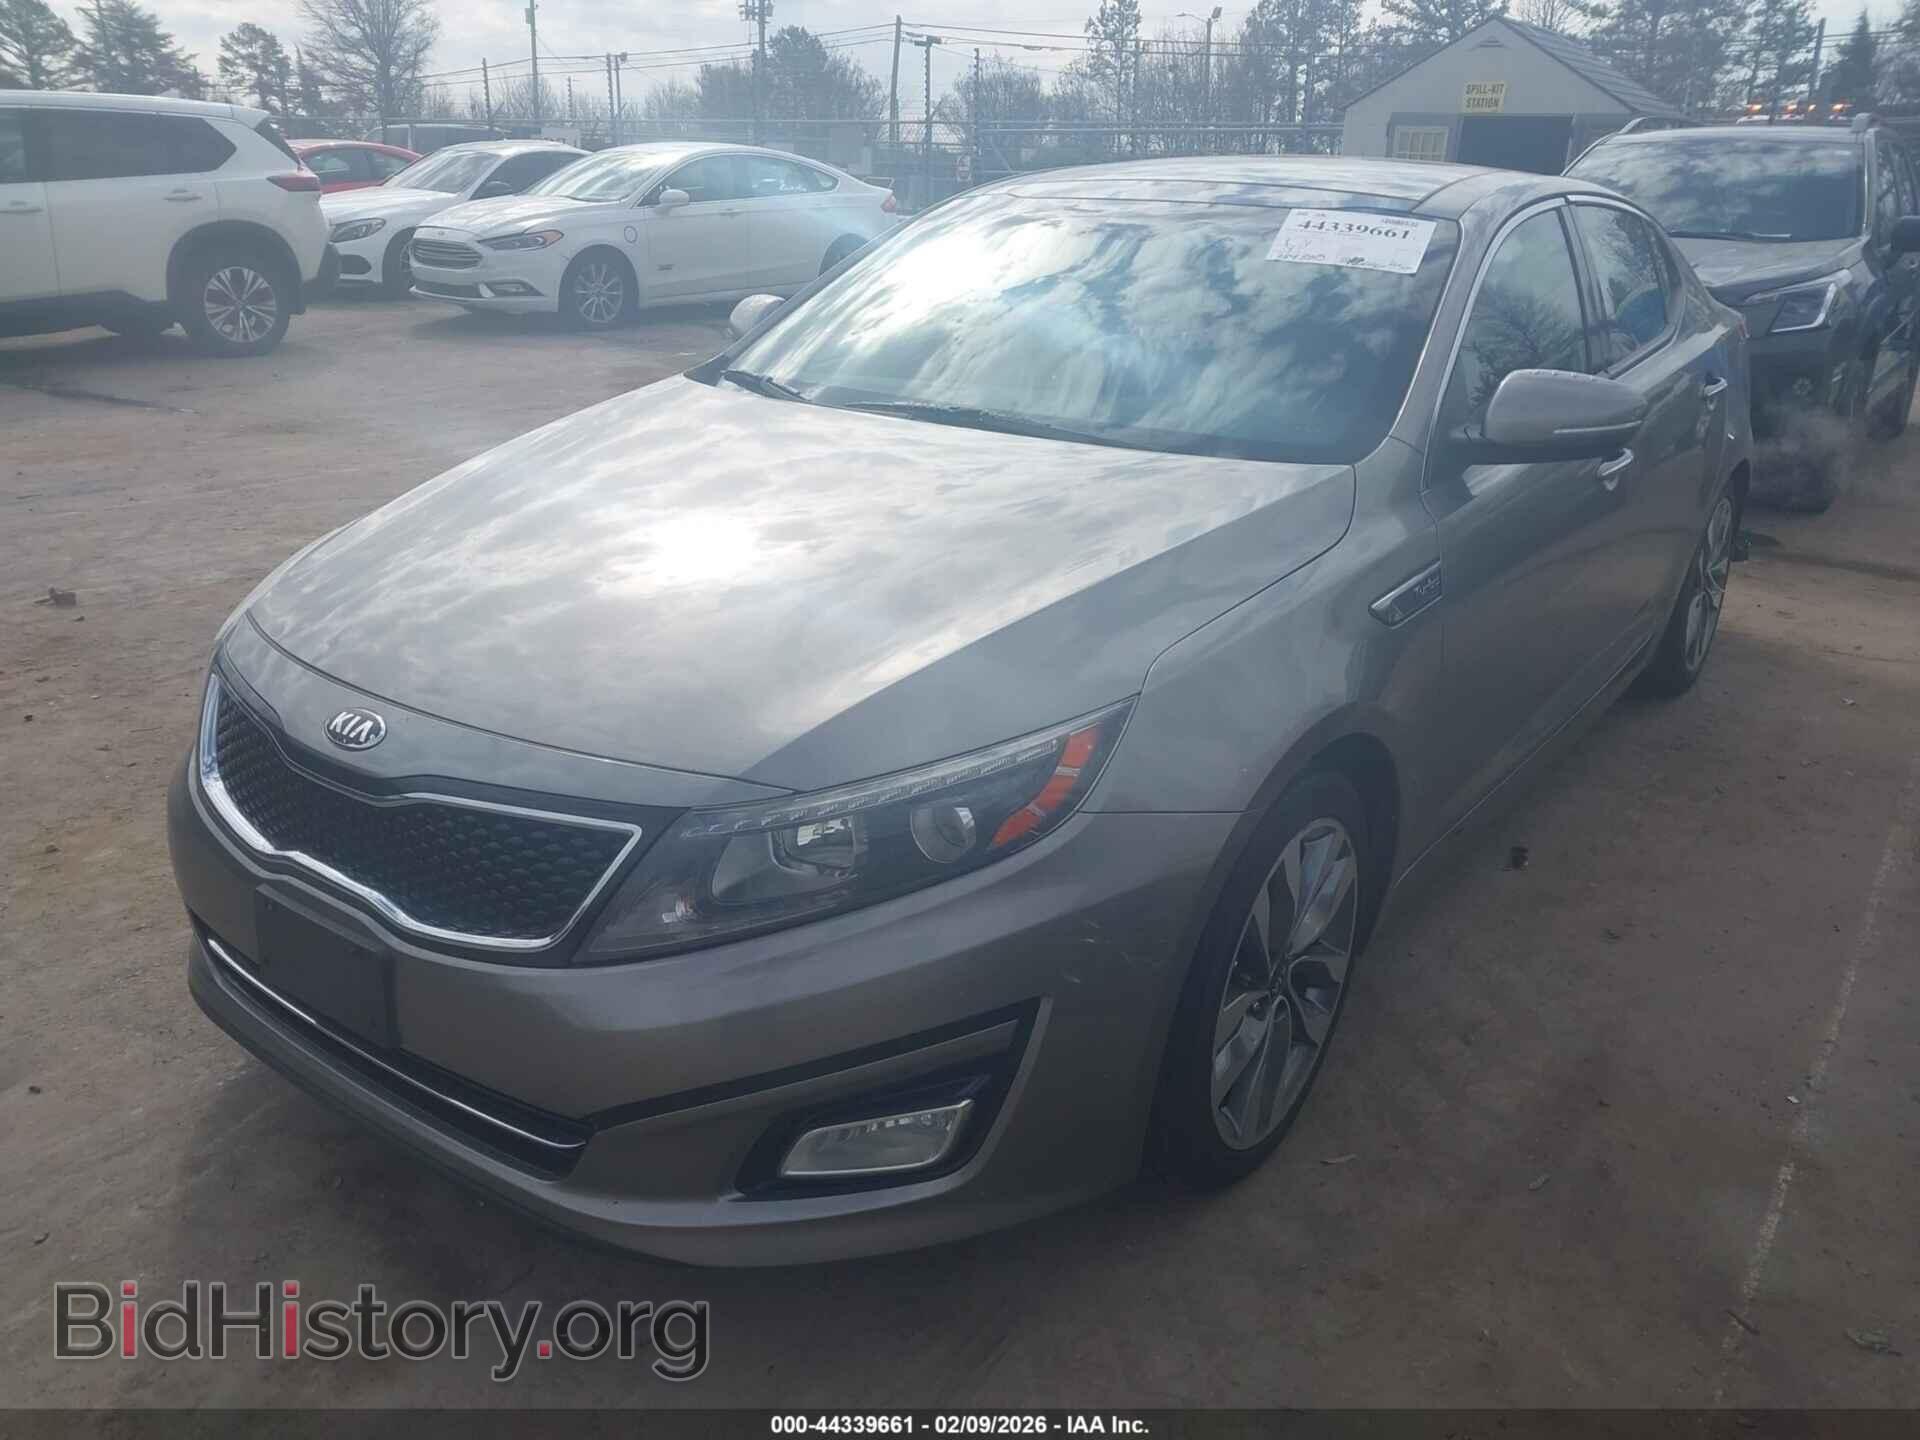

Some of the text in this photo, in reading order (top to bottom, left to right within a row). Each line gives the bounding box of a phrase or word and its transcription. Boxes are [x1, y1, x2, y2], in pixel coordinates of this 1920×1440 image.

[1465, 83, 1505, 95] SPILL-KIT
[1465, 97, 1500, 109] STATION
[1297, 219, 1412, 240] 44339661
[329, 711, 374, 742] KIA
